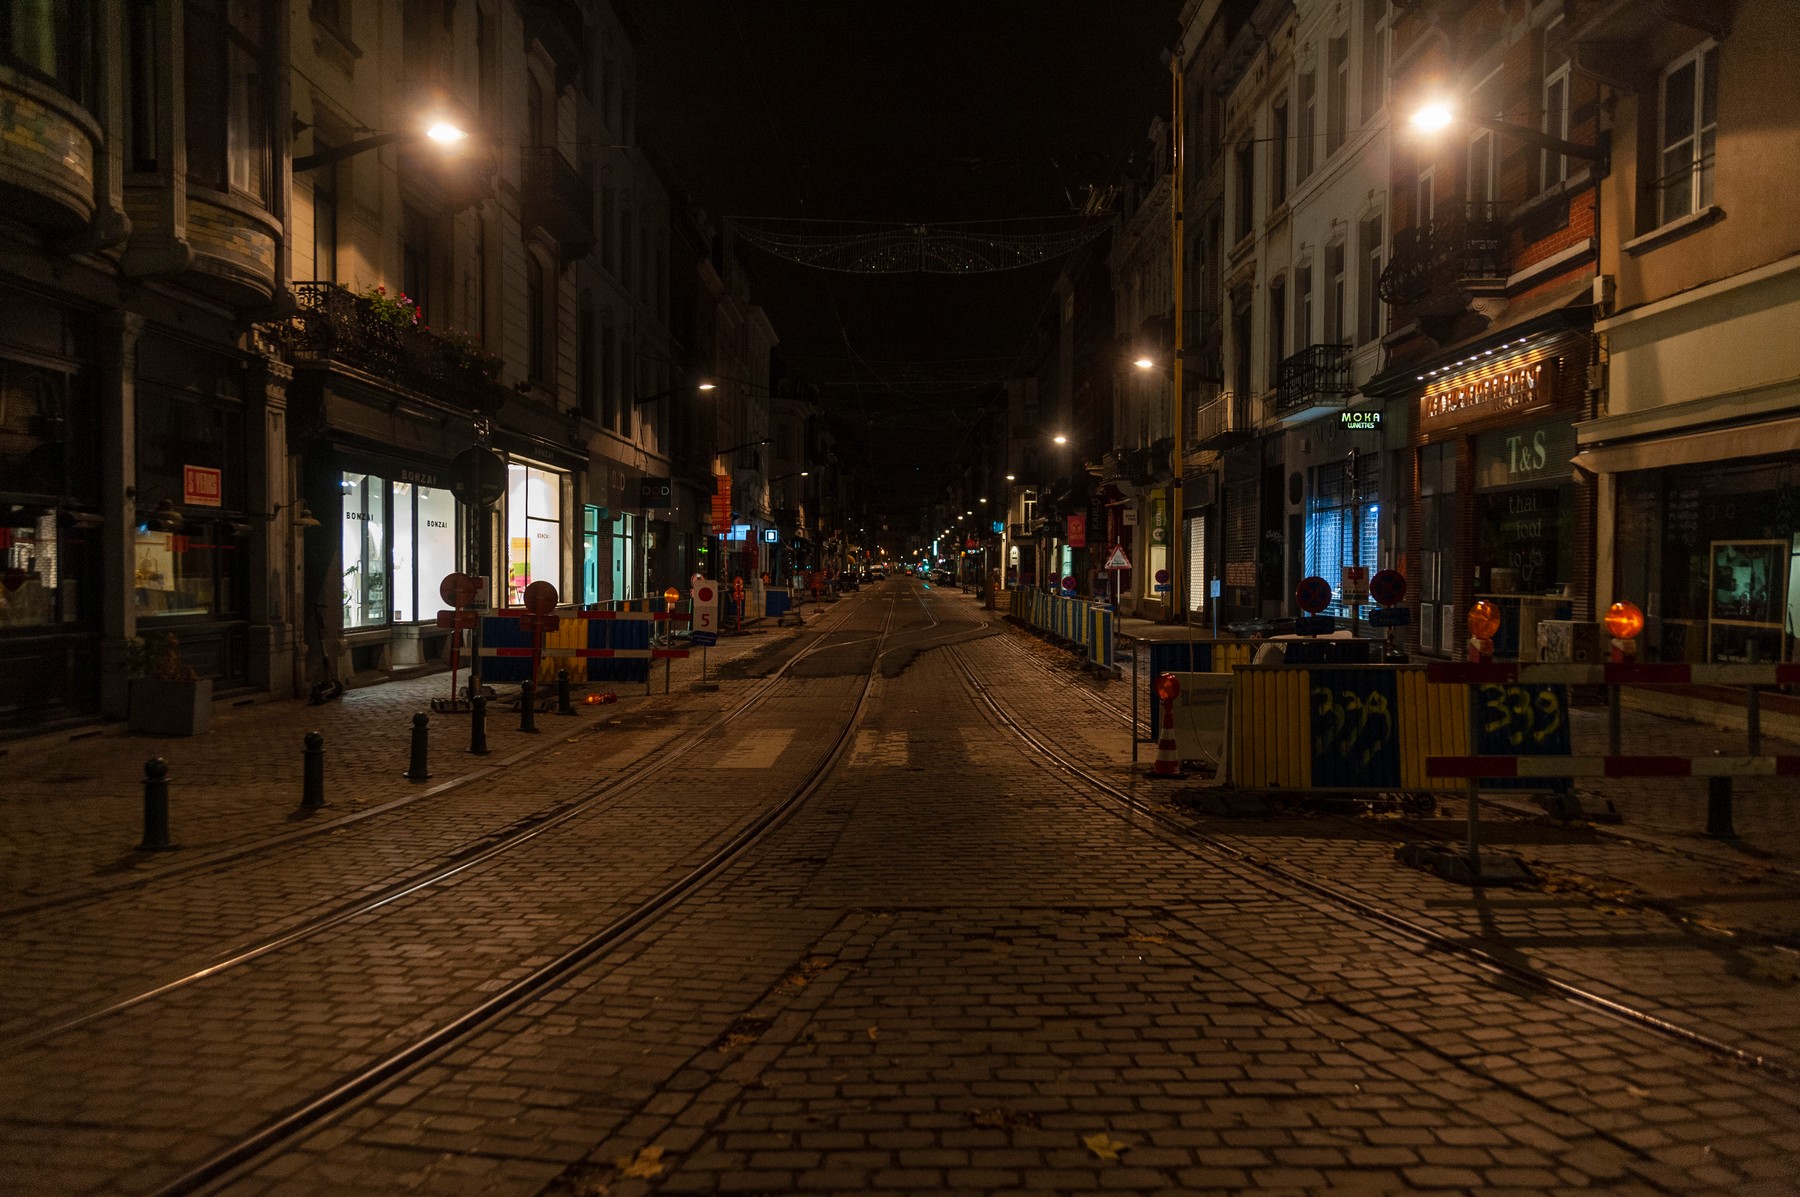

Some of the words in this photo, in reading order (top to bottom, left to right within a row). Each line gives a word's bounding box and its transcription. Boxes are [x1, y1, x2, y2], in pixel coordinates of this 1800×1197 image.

[1341, 412, 1381, 423] MOKA
[1506, 430, 1546, 474] T&S
[401, 469, 437, 485] BONZAI
[1508, 493, 1538, 514] thai
[346, 511, 374, 521] BONZAI
[427, 520, 448, 528] BONZAI
[1516, 518, 1542, 540] food
[701, 613, 710, 627] 5
[1480, 683, 1562, 743] 339
